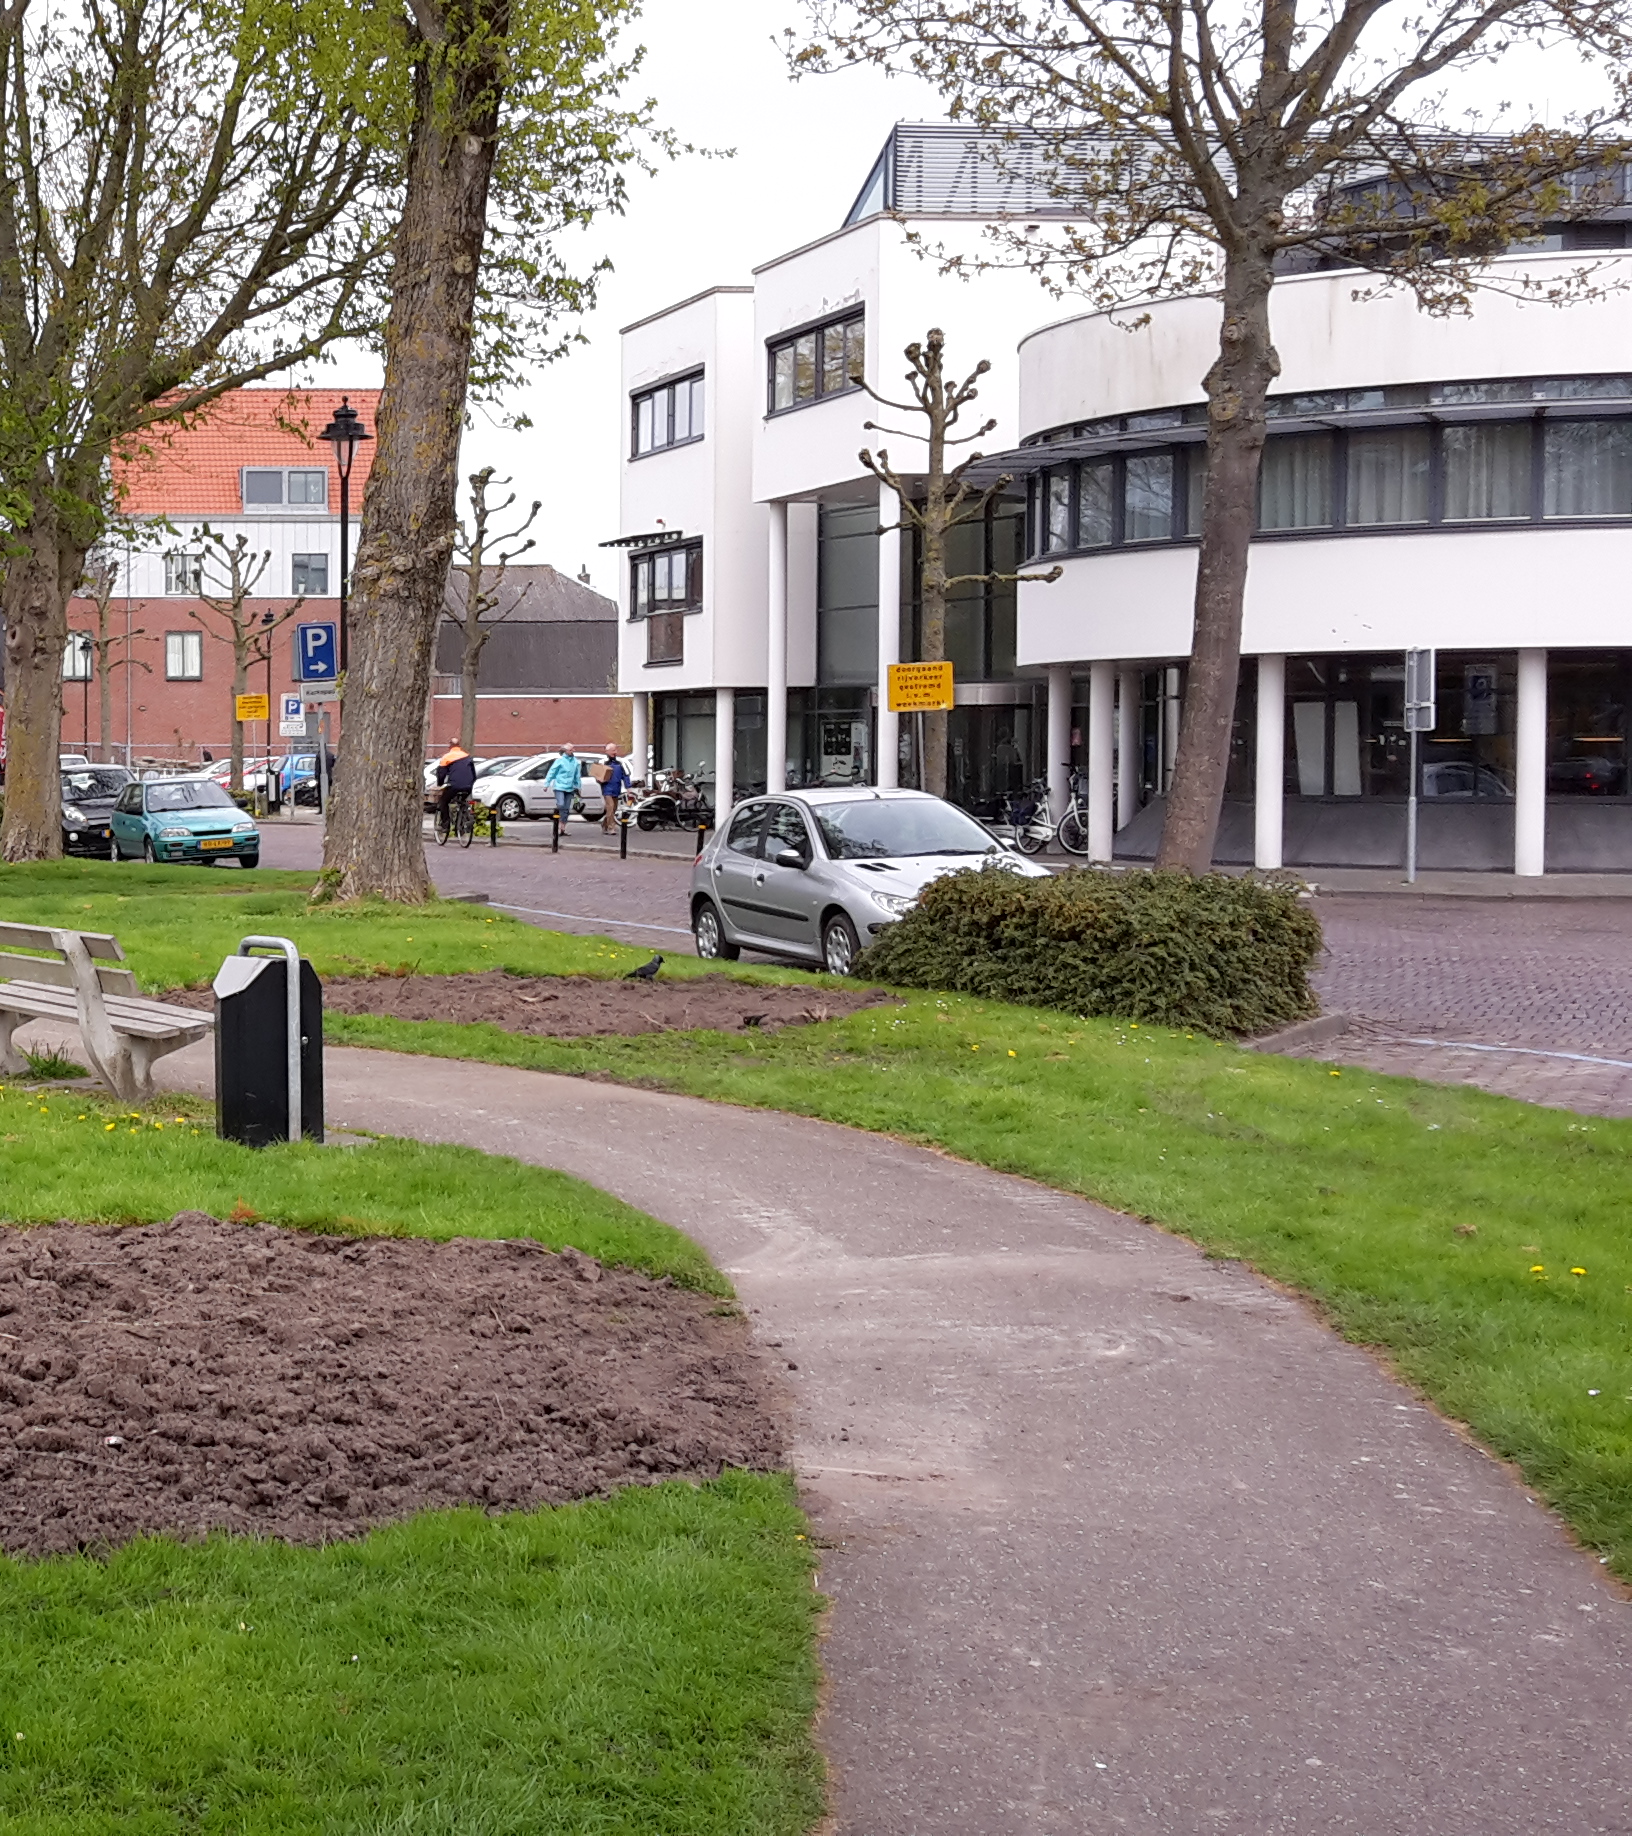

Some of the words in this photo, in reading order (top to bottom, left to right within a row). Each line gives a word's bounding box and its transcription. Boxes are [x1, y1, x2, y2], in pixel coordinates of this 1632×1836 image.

[306, 628, 328, 658] P
[896, 665, 943, 673] doorgaand
[897, 674, 943, 682] rijverkeer
[288, 700, 298, 713] P
